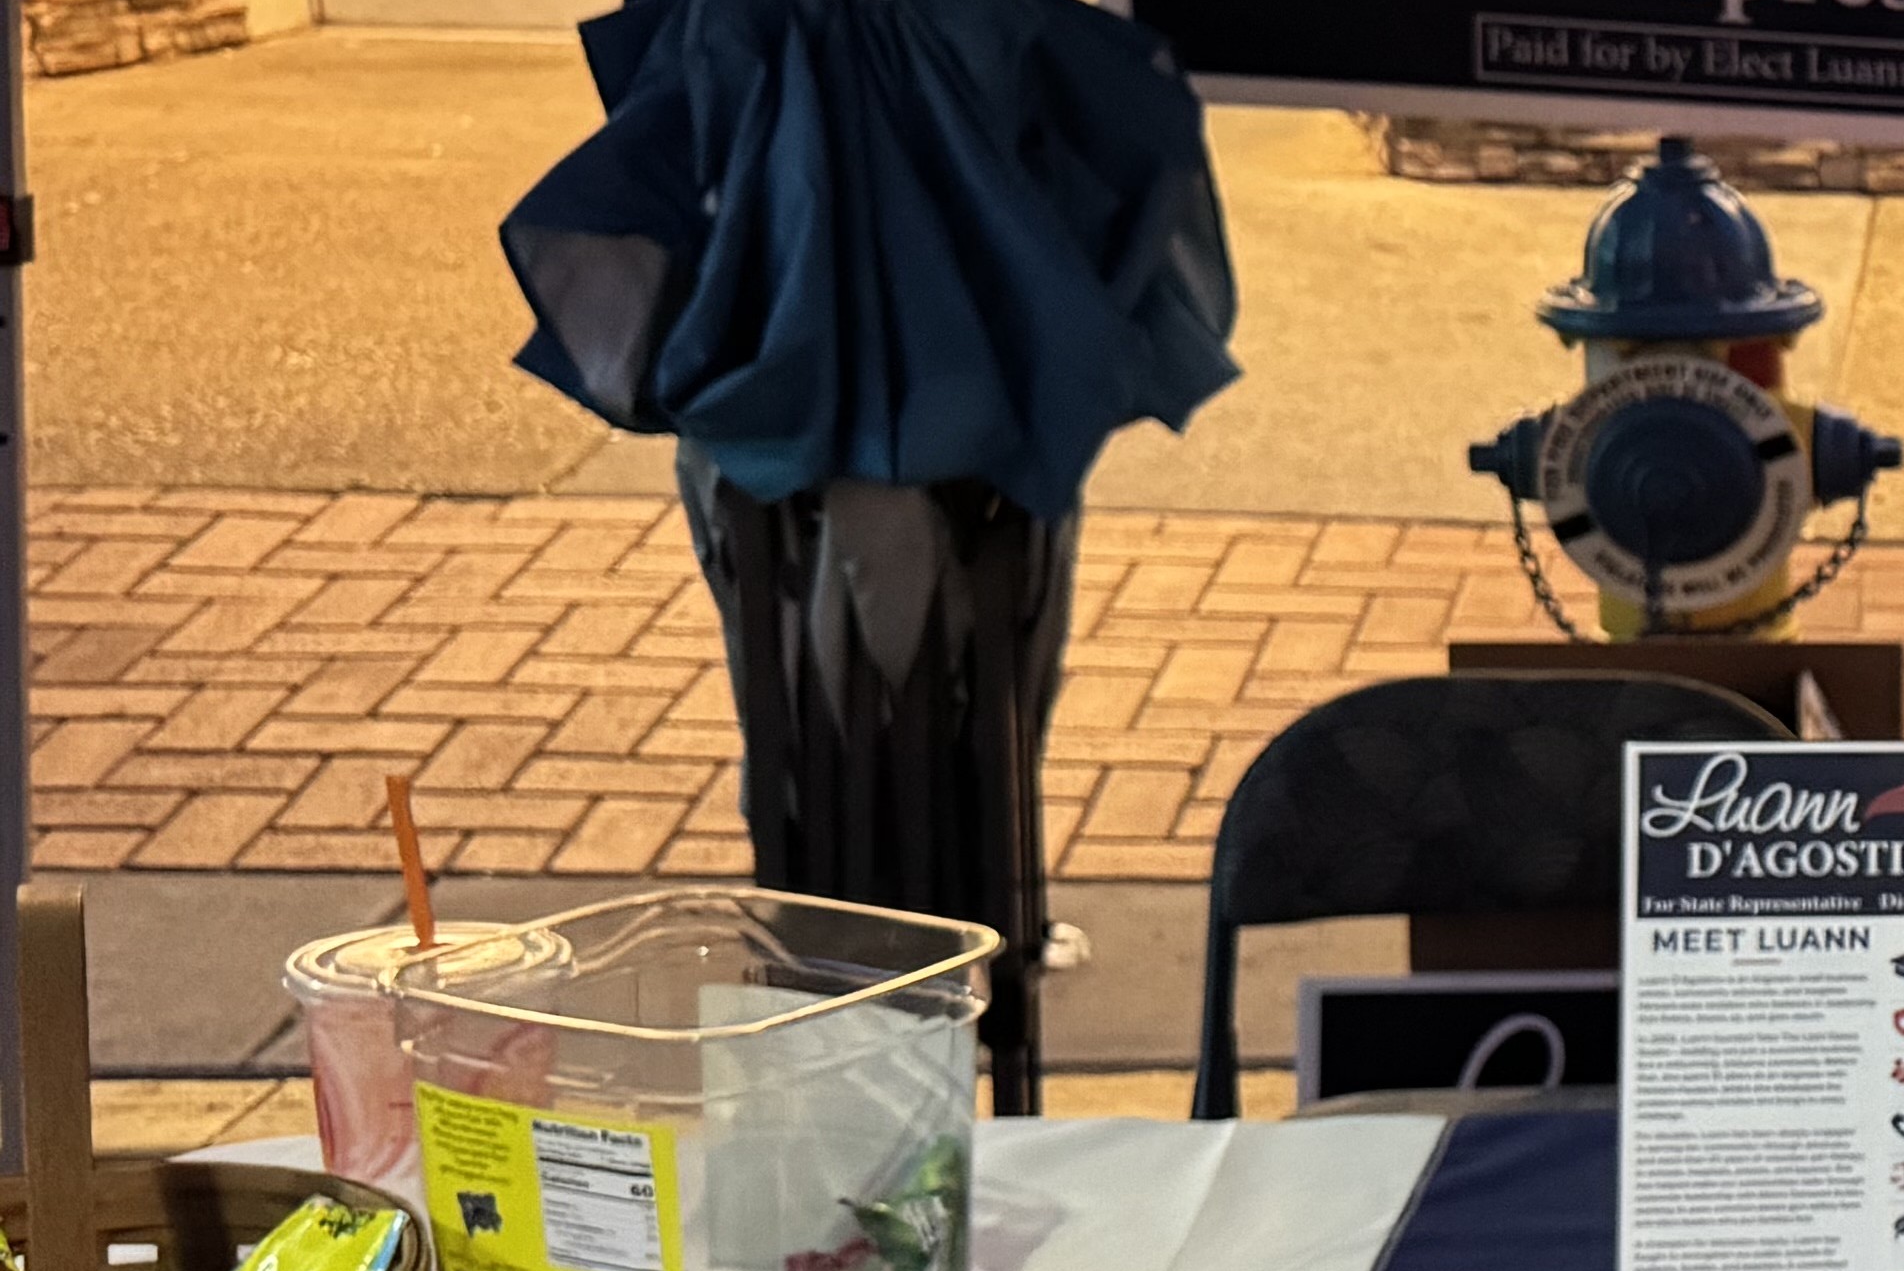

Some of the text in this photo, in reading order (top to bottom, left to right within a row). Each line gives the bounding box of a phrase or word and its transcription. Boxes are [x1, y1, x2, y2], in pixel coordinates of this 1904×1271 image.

[1487, 26, 1570, 67] Paid
[1580, 29, 1632, 71] for
[1646, 34, 1691, 82] by
[1703, 36, 1794, 80] Elect
[1641, 752, 1861, 838] Luann
[1653, 926, 1871, 953] MEET LUANN
